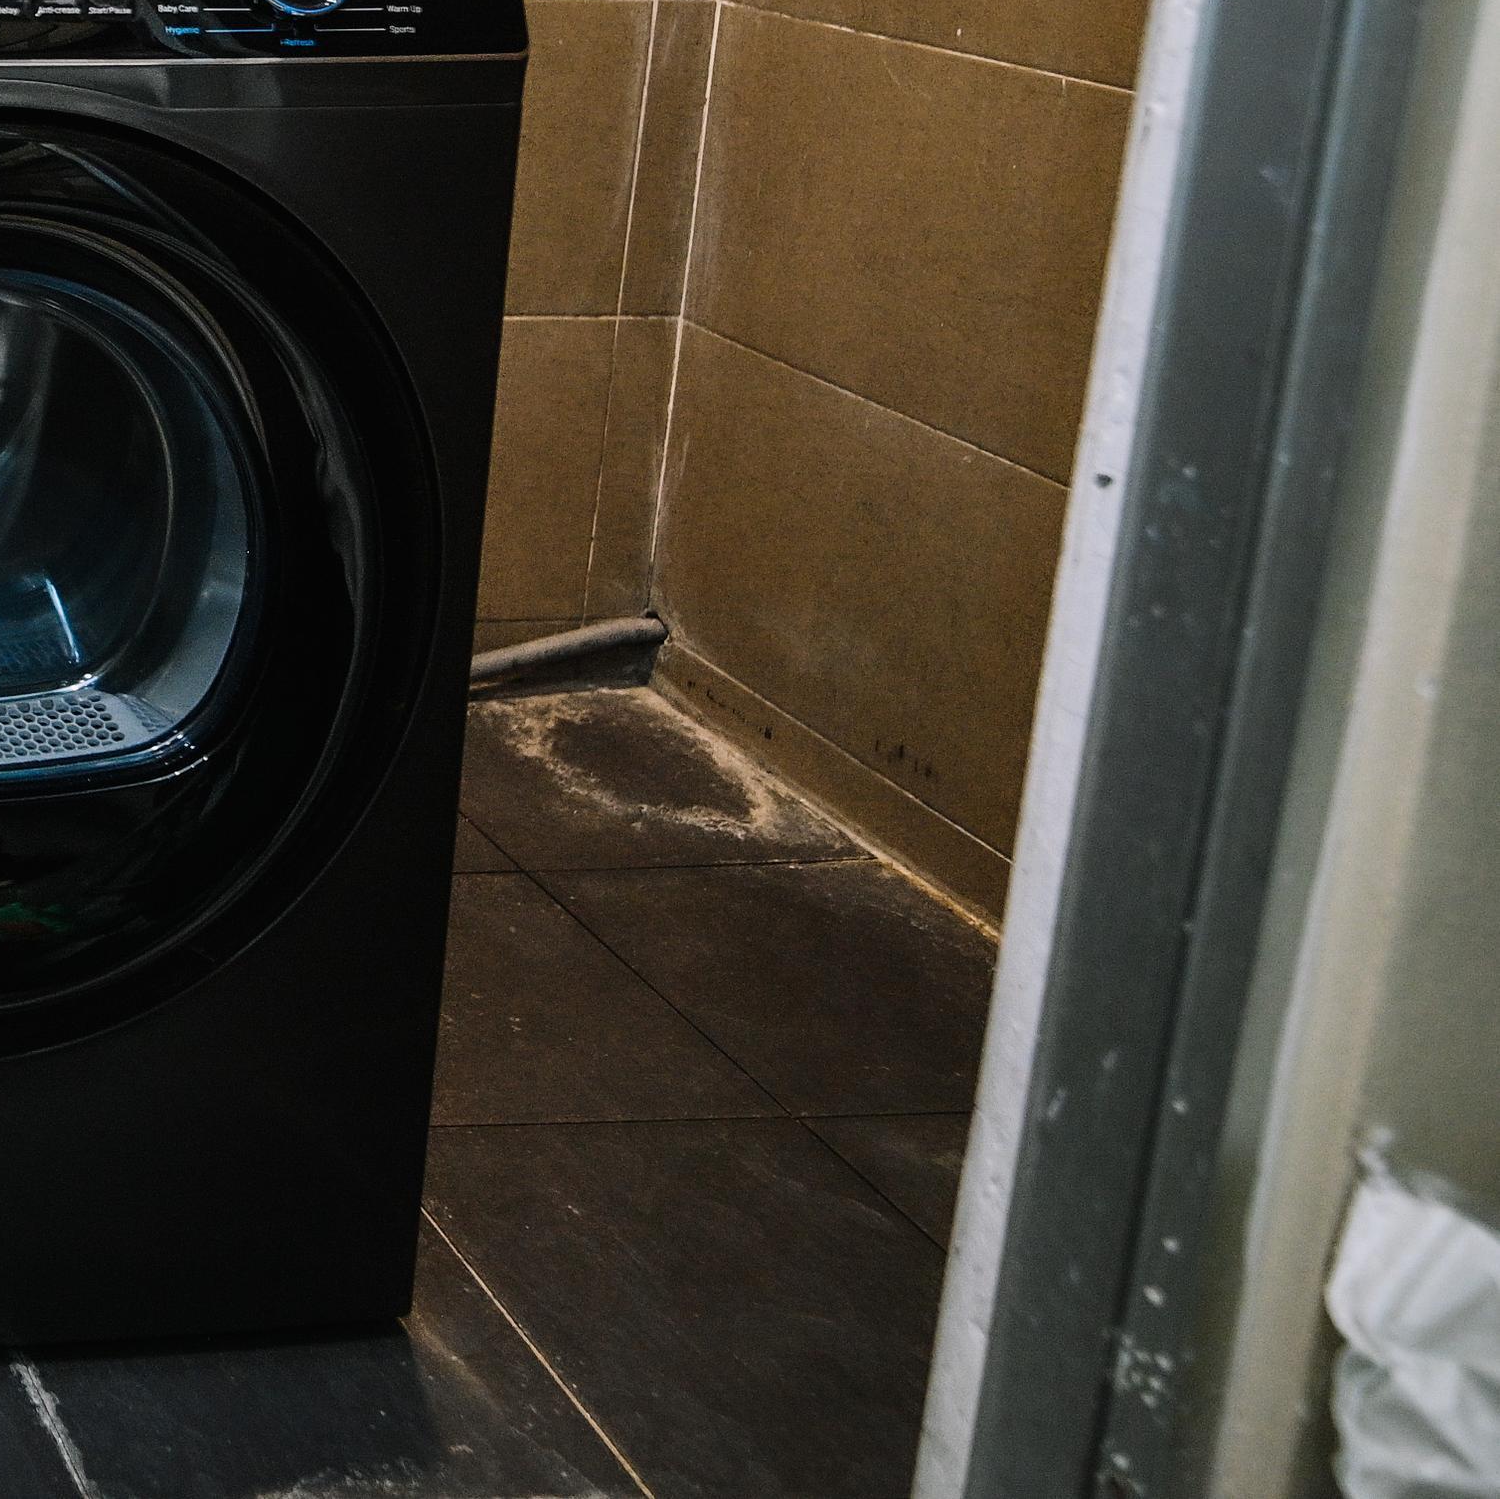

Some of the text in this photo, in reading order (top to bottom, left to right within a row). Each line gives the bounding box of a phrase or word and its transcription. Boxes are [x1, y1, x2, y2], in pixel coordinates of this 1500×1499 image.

[38, 6, 80, 14] Anti-crease
[158, 5, 178, 13] Baby
[387, 5, 408, 13] Warm
[389, 26, 415, 34] Sports
